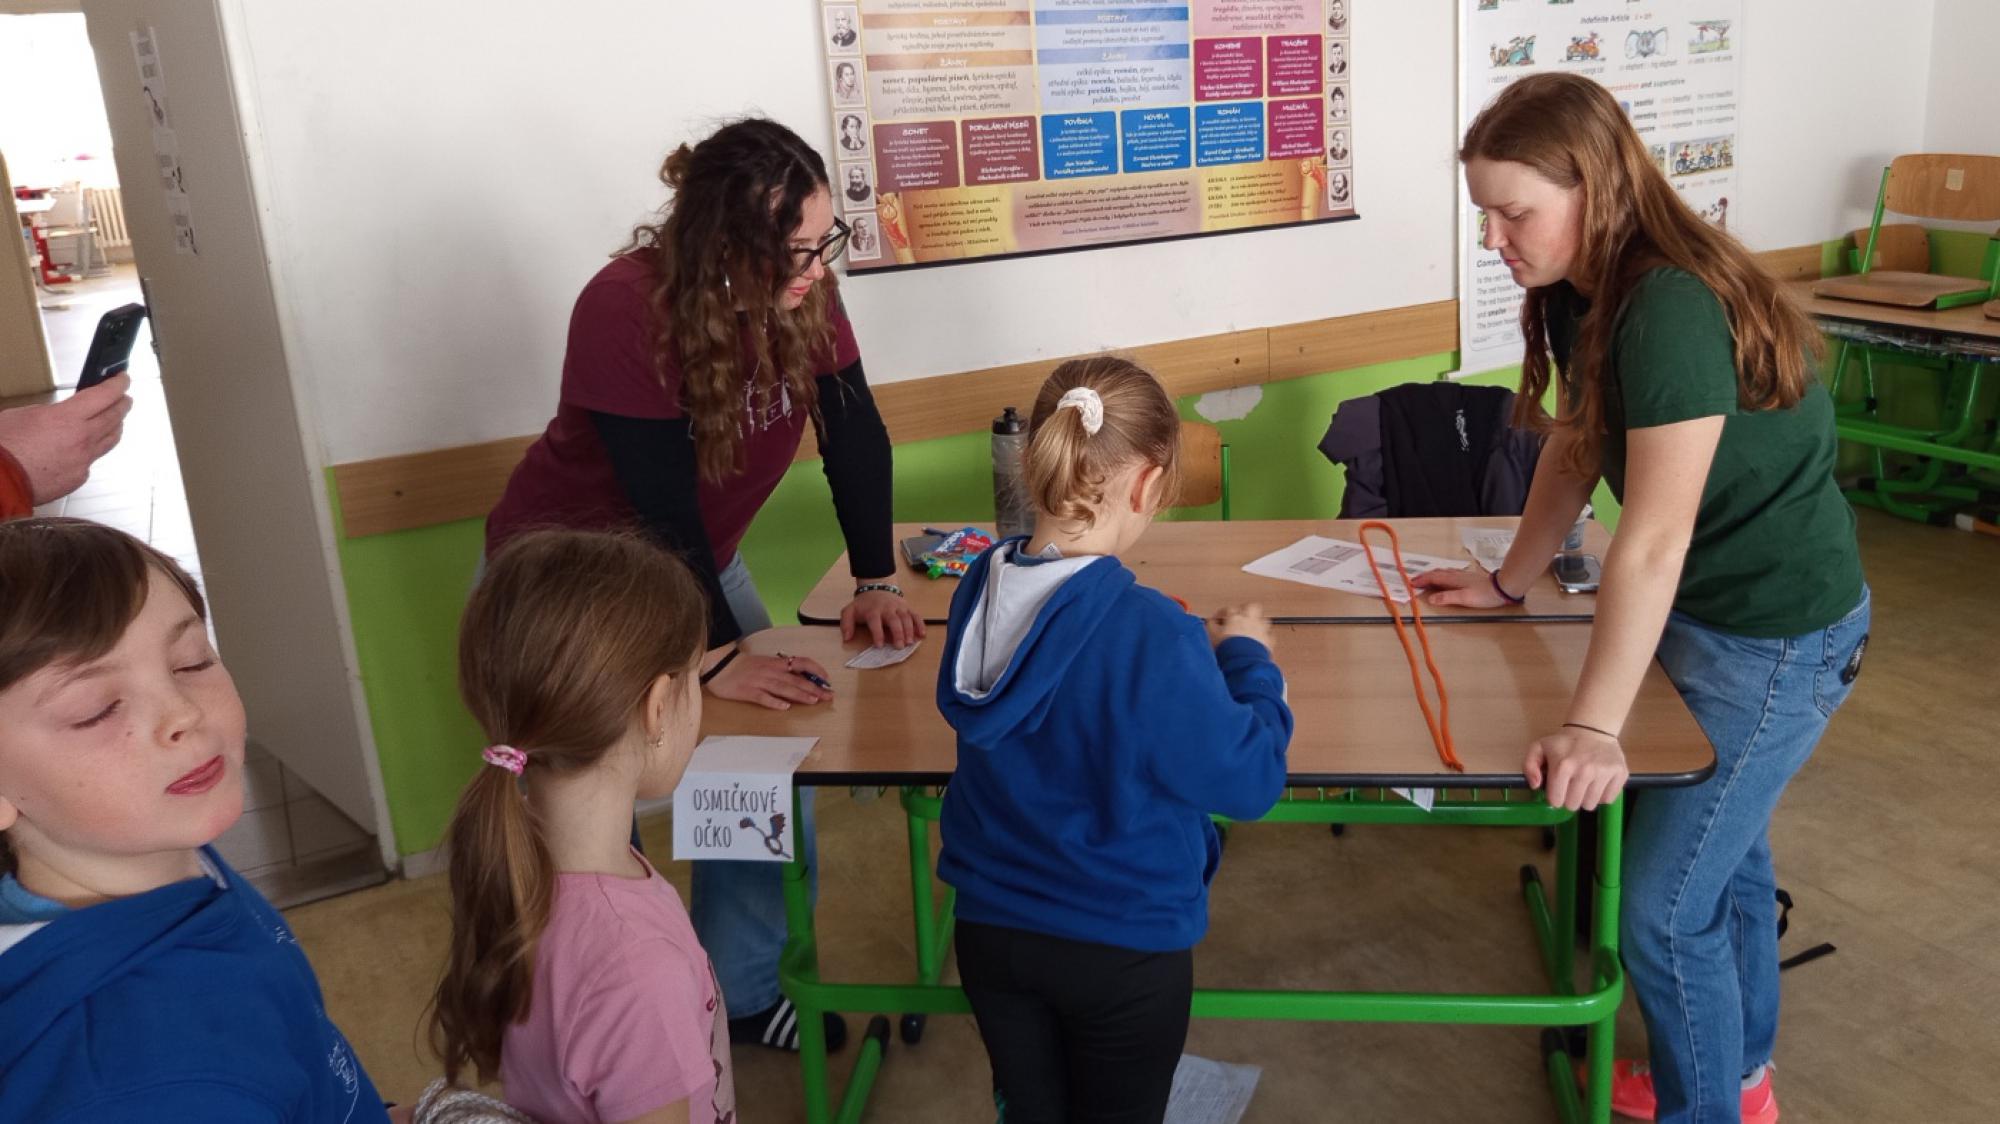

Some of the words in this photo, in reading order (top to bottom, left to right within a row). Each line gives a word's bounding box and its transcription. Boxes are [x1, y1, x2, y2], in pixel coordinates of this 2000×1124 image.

[1610, 14, 1630, 23] Article
[902, 128, 929, 136] SONET
[1477, 259, 1501, 268] Compa
[693, 782, 778, 813] OSMIČKOVÉ
[694, 818, 732, 848] OČKO
